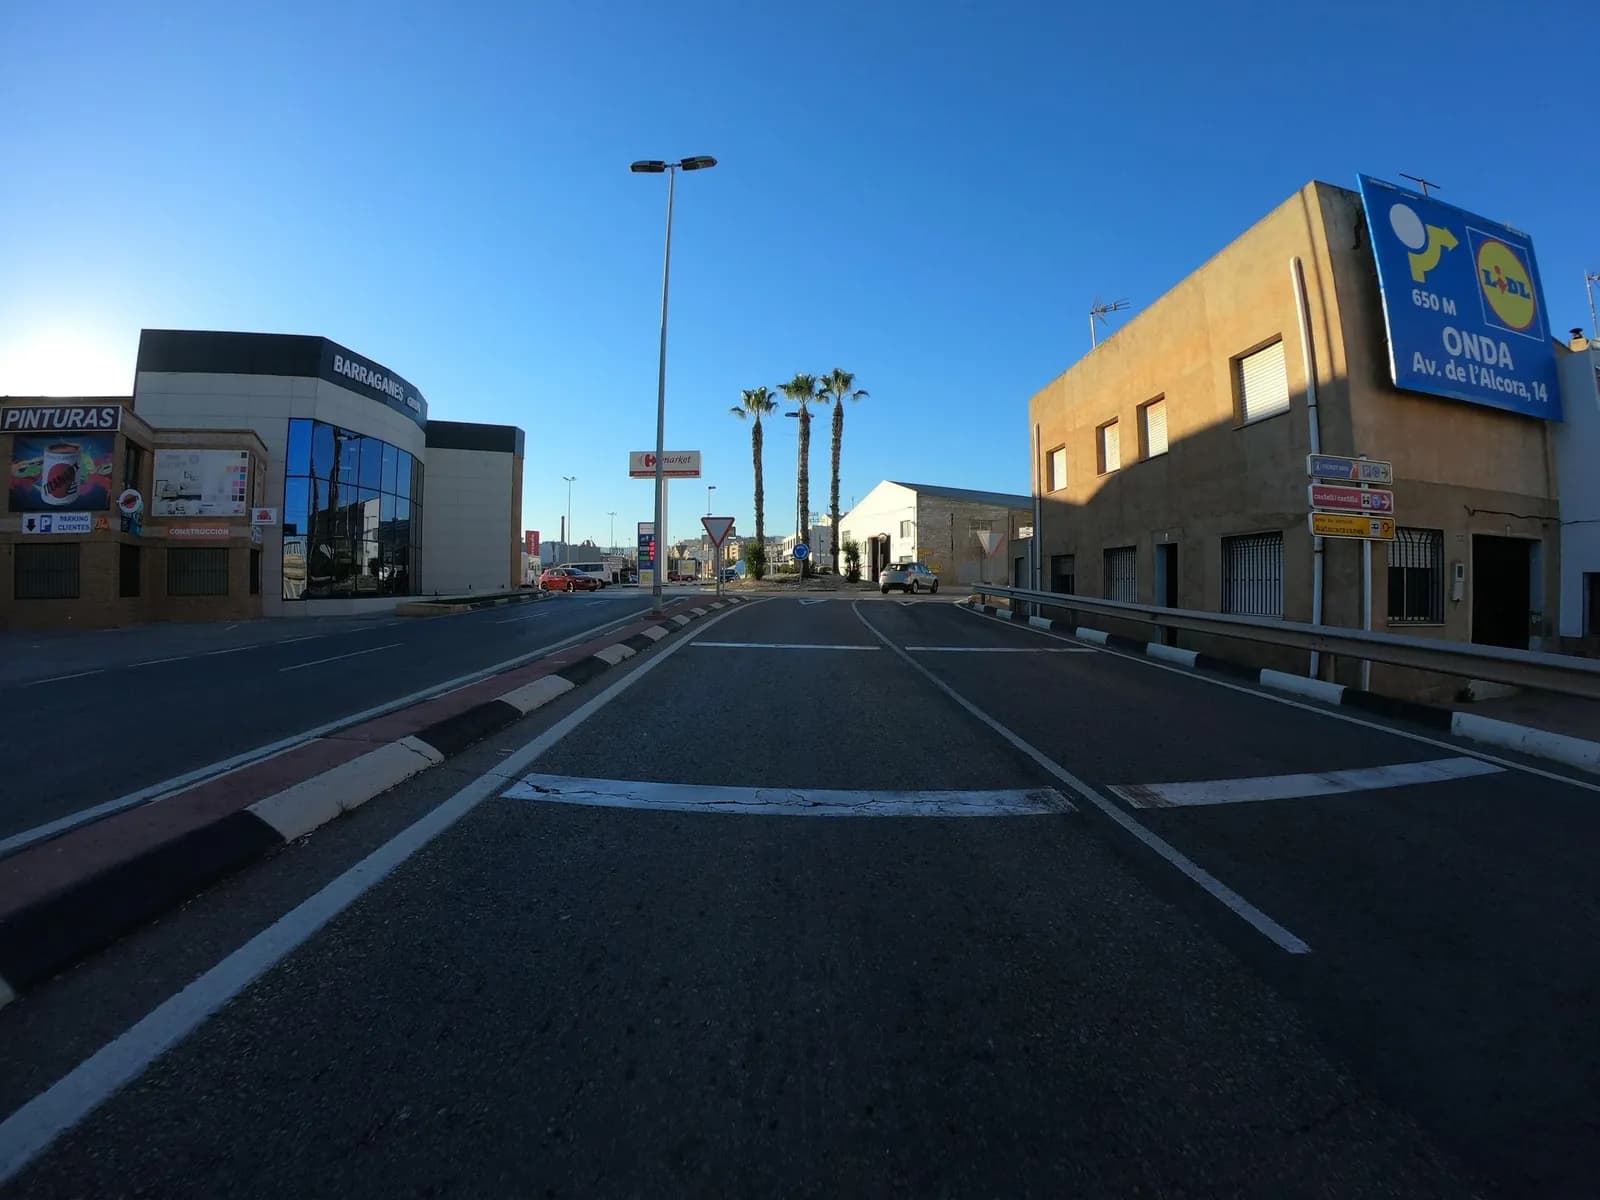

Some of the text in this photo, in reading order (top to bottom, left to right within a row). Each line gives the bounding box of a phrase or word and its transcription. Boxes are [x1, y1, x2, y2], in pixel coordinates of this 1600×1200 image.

[1412, 288, 1457, 316] 650 M
[1442, 326, 1514, 370] ONDA
[334, 355, 404, 402] BARRAGANES
[1413, 352, 1442, 377] Av.
[1445, 359, 1466, 384] de
[1532, 381, 1549, 405] 14
[4, 408, 115, 429] PINTURAS
